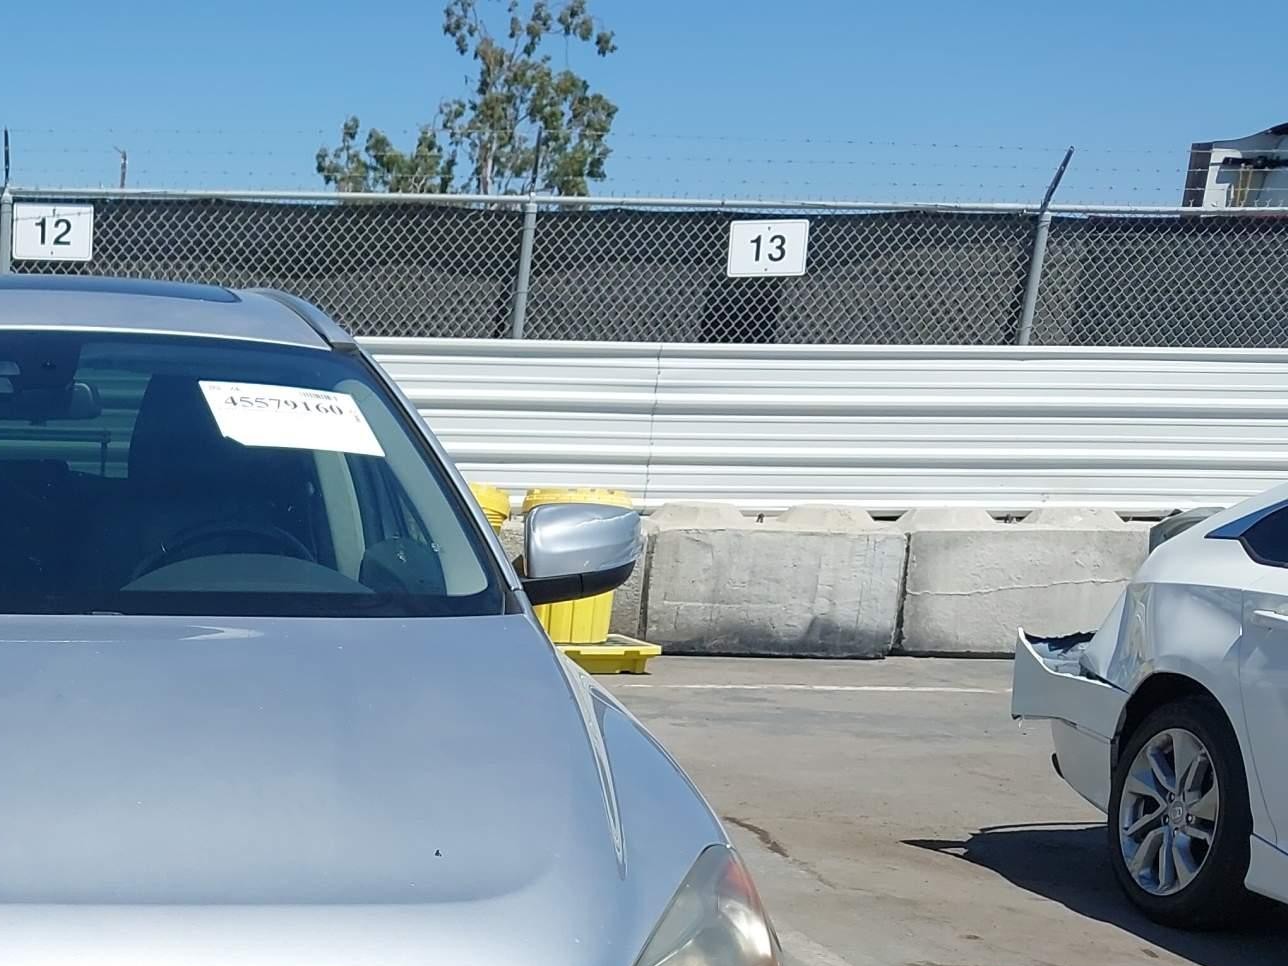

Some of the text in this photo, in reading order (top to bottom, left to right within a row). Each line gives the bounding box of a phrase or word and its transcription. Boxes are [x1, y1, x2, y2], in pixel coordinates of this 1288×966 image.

[34, 217, 72, 246] 12
[749, 234, 787, 263] 13
[224, 395, 344, 416] 45579160
